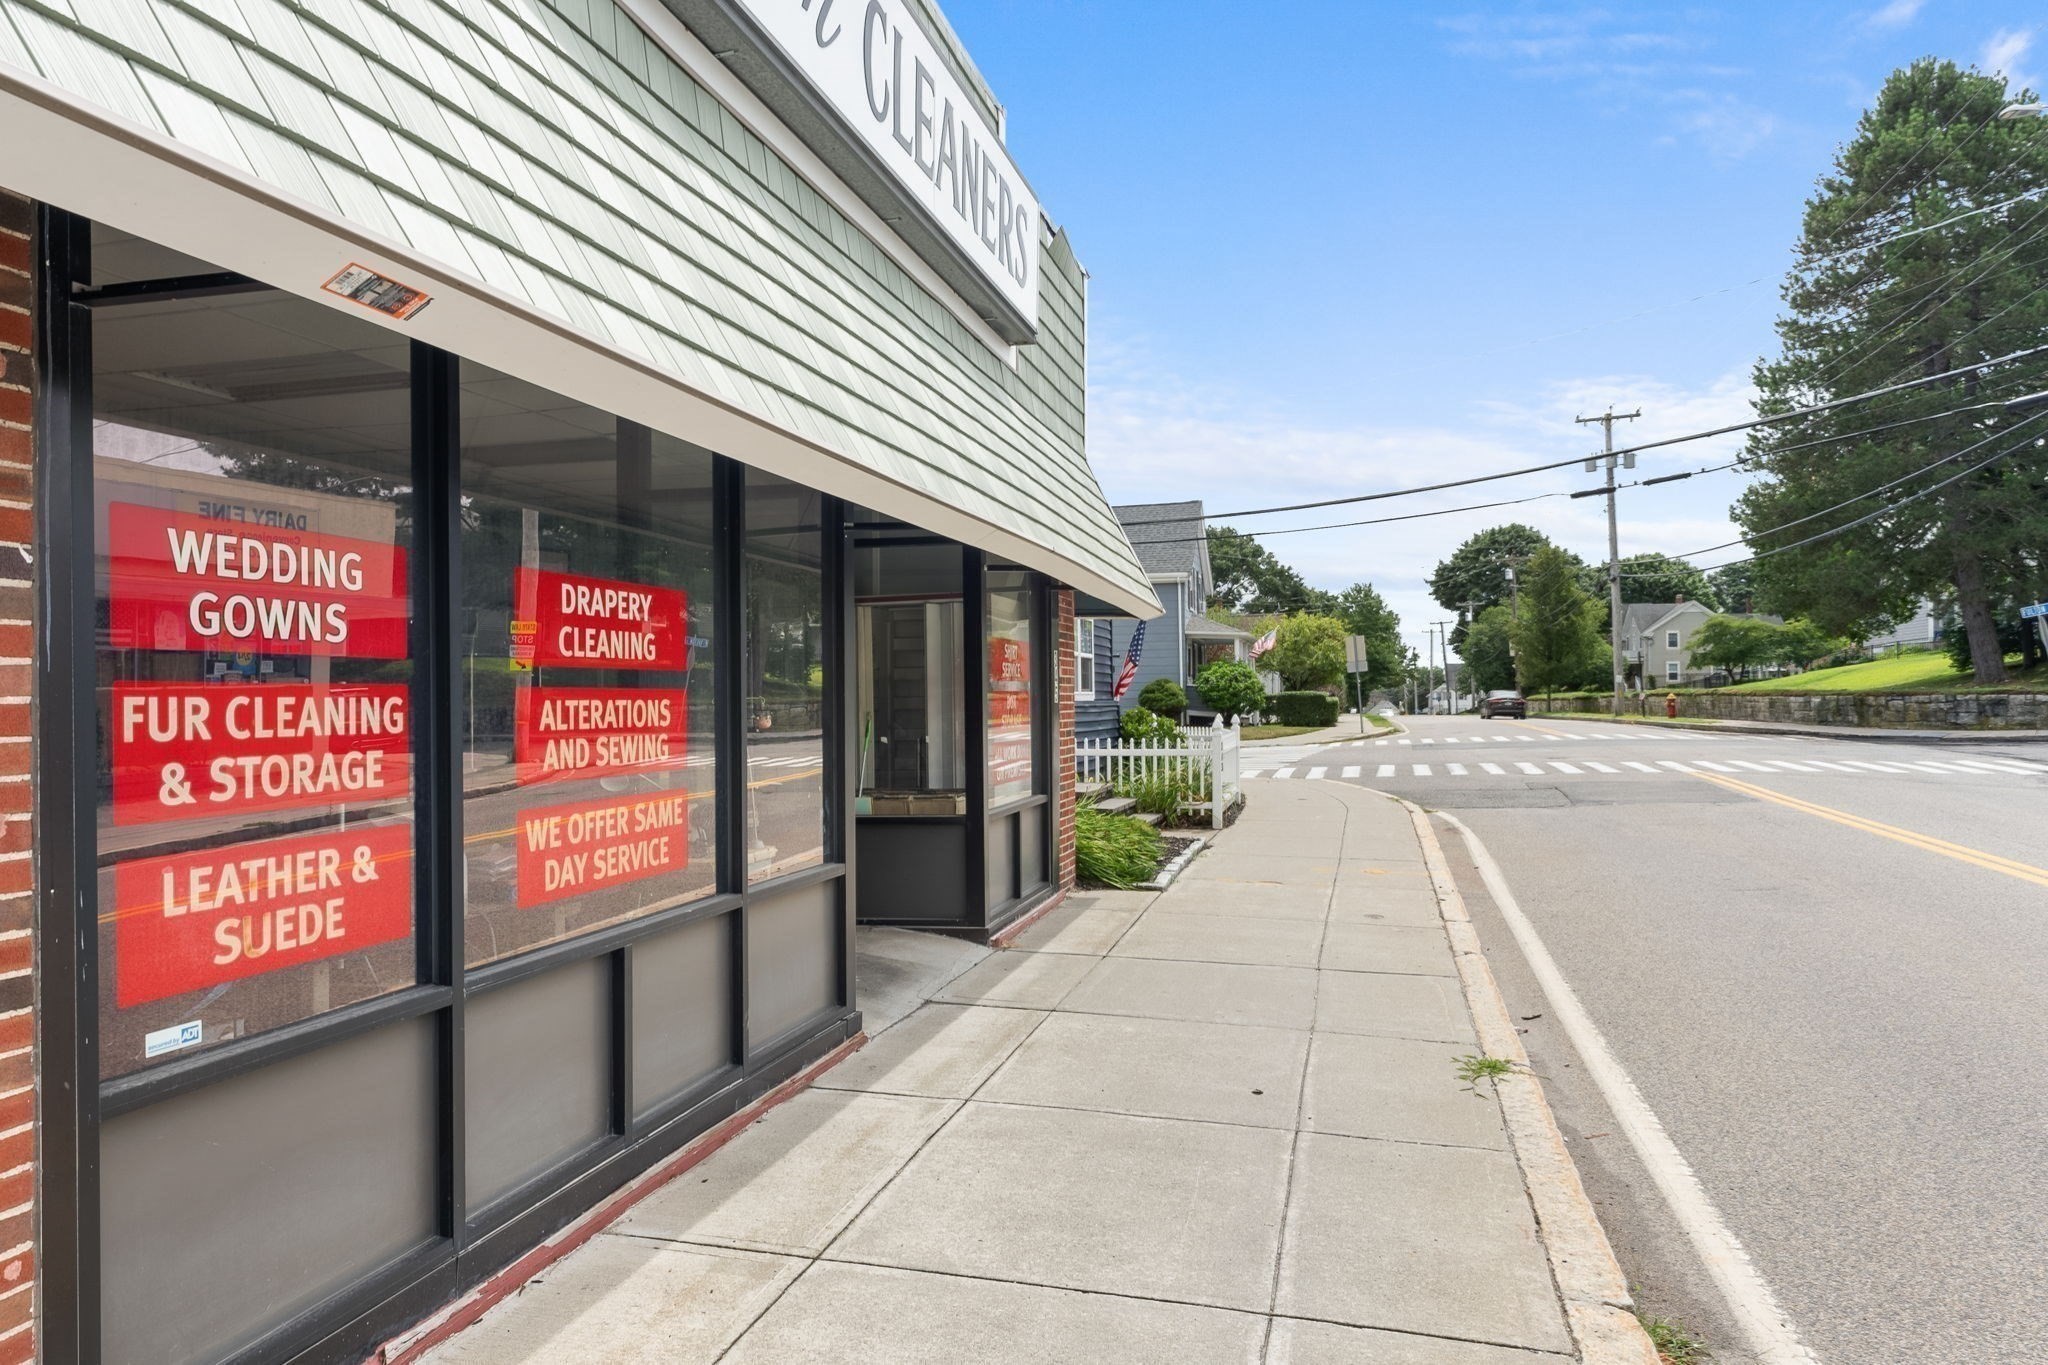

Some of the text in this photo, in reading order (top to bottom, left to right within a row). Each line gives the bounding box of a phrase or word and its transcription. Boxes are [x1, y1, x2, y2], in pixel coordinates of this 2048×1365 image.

[863, 0, 1028, 288] CLEANERS
[167, 527, 363, 591] WEDDING
[189, 591, 348, 643] GOWNS
[561, 583, 652, 621] DRAPERY
[558, 626, 656, 660] CLEANING
[1002, 662, 1021, 678] SERVICE
[123, 695, 404, 743] FUR CLEANING
[539, 699, 671, 732] ALTERATIONS
[159, 750, 384, 806] & STORAGE
[543, 733, 669, 772] AND SEWING
[525, 798, 683, 852] WE OFFER SAME
[162, 845, 379, 918] LEATHER &
[545, 836, 669, 892] DAY SERVICE
[213, 897, 345, 965] SUEDE
[182, 1027, 199, 1041] ADT
